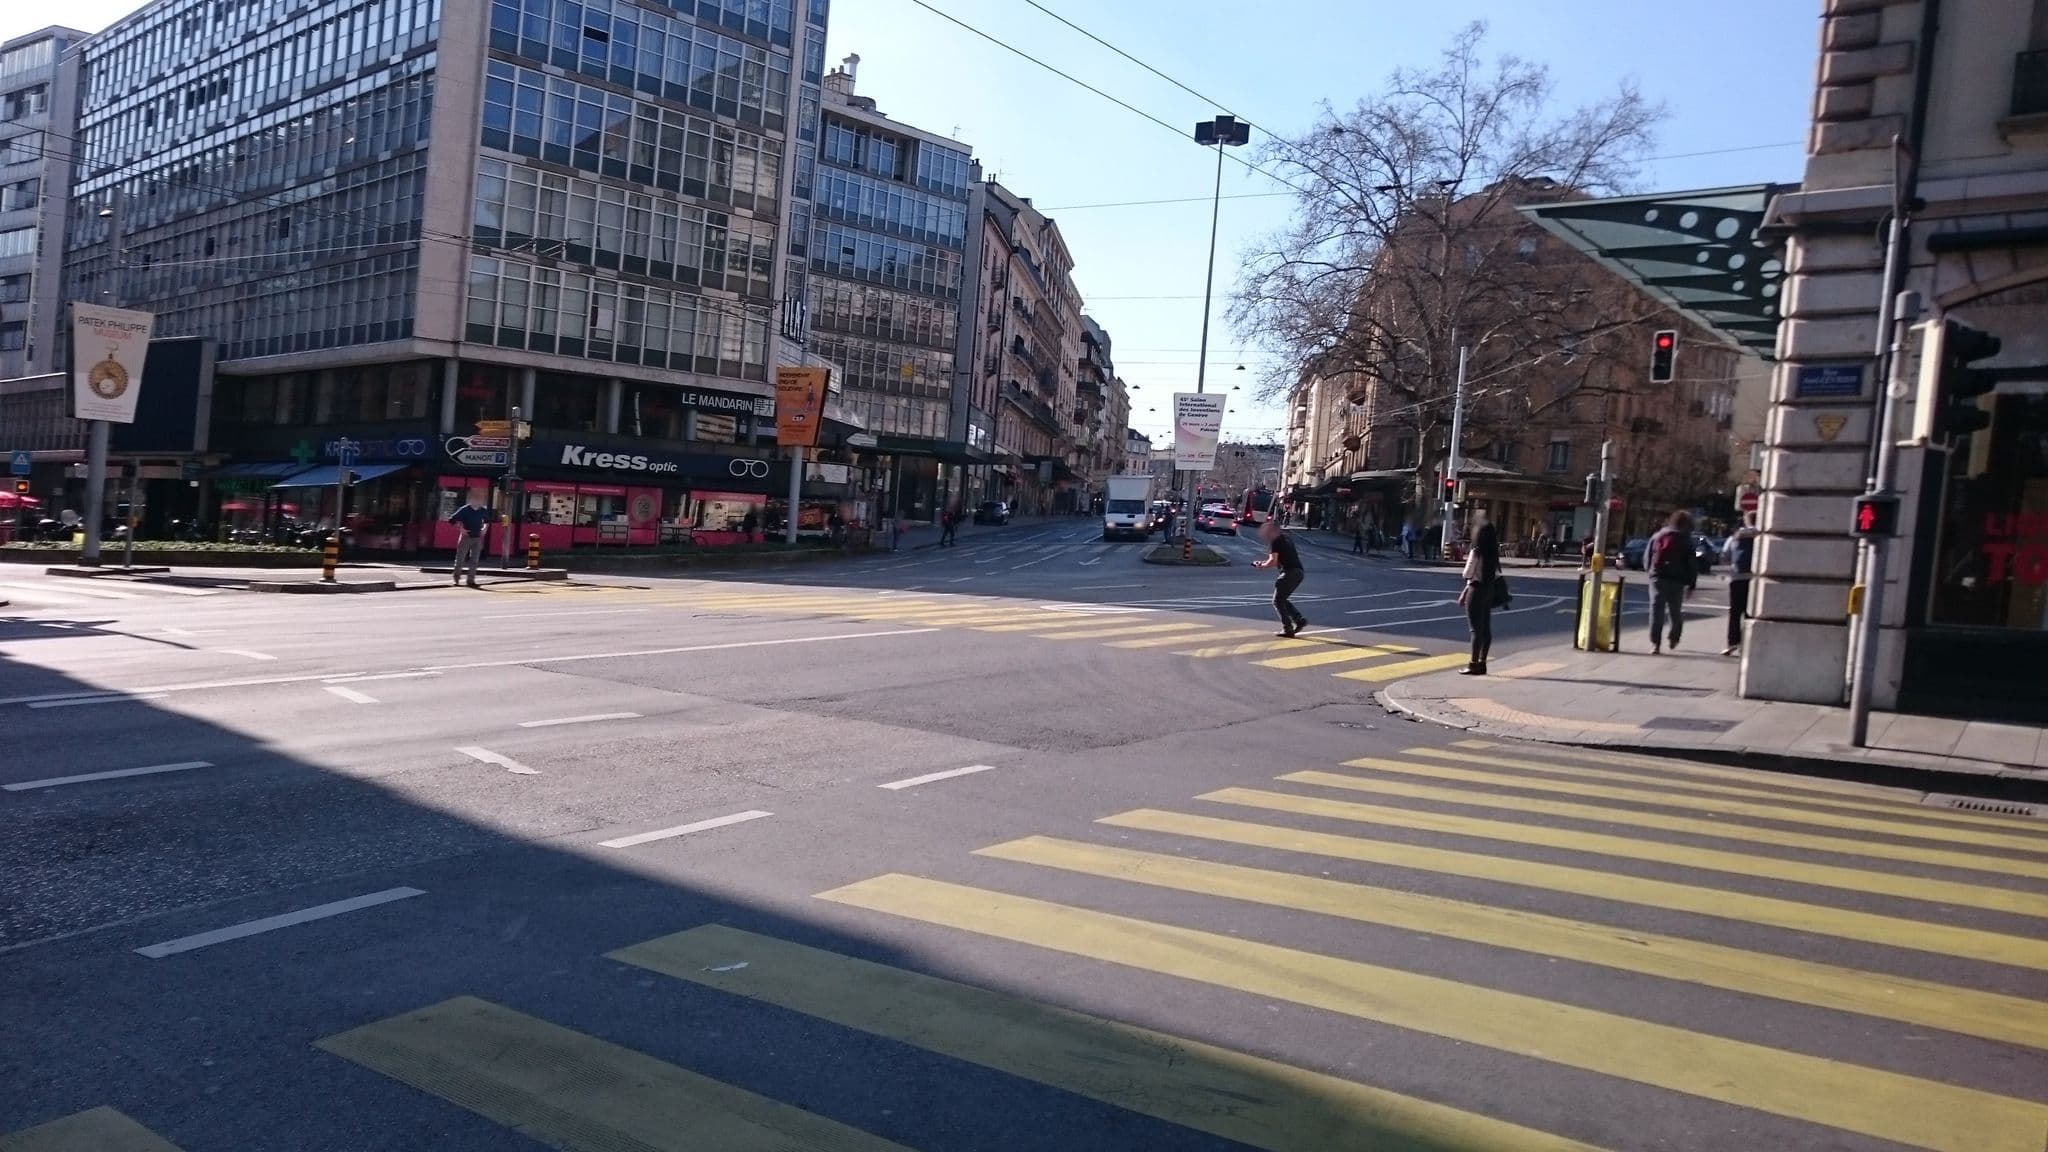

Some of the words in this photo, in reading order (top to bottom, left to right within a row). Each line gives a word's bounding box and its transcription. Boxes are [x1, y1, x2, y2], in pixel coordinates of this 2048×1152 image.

[78, 316, 107, 328] PATEK
[108, 320, 148, 334] PHILIPPE
[94, 328, 131, 340] MUSEUM
[682, 392, 697, 405] LE
[698, 394, 754, 412] MANDARIN
[324, 440, 361, 457] KRSS
[465, 454, 493, 463] MANOR
[560, 444, 648, 471] Kress
[648, 461, 679, 474] optic
